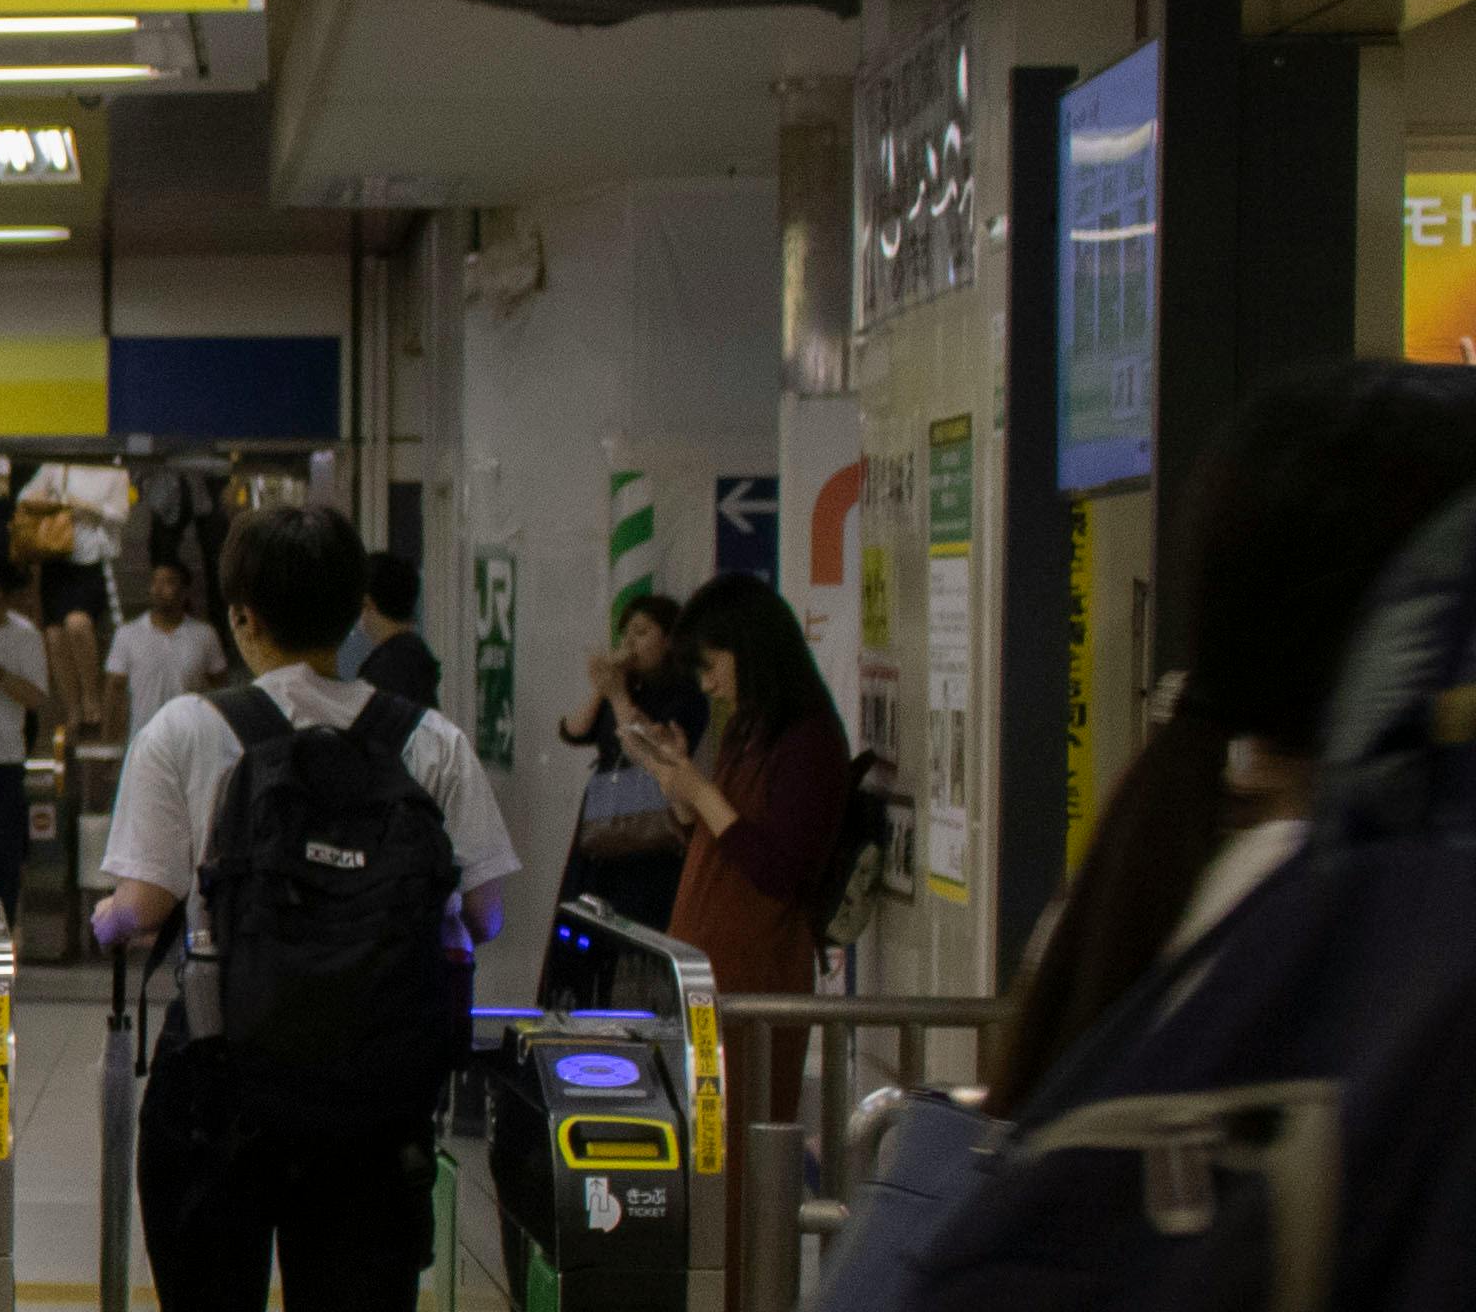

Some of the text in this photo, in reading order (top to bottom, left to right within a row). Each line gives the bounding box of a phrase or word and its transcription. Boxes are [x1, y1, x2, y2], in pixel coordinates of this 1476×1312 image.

[626, 1188, 667, 1206] きっぷ
[626, 1206, 667, 1218] TICKET
